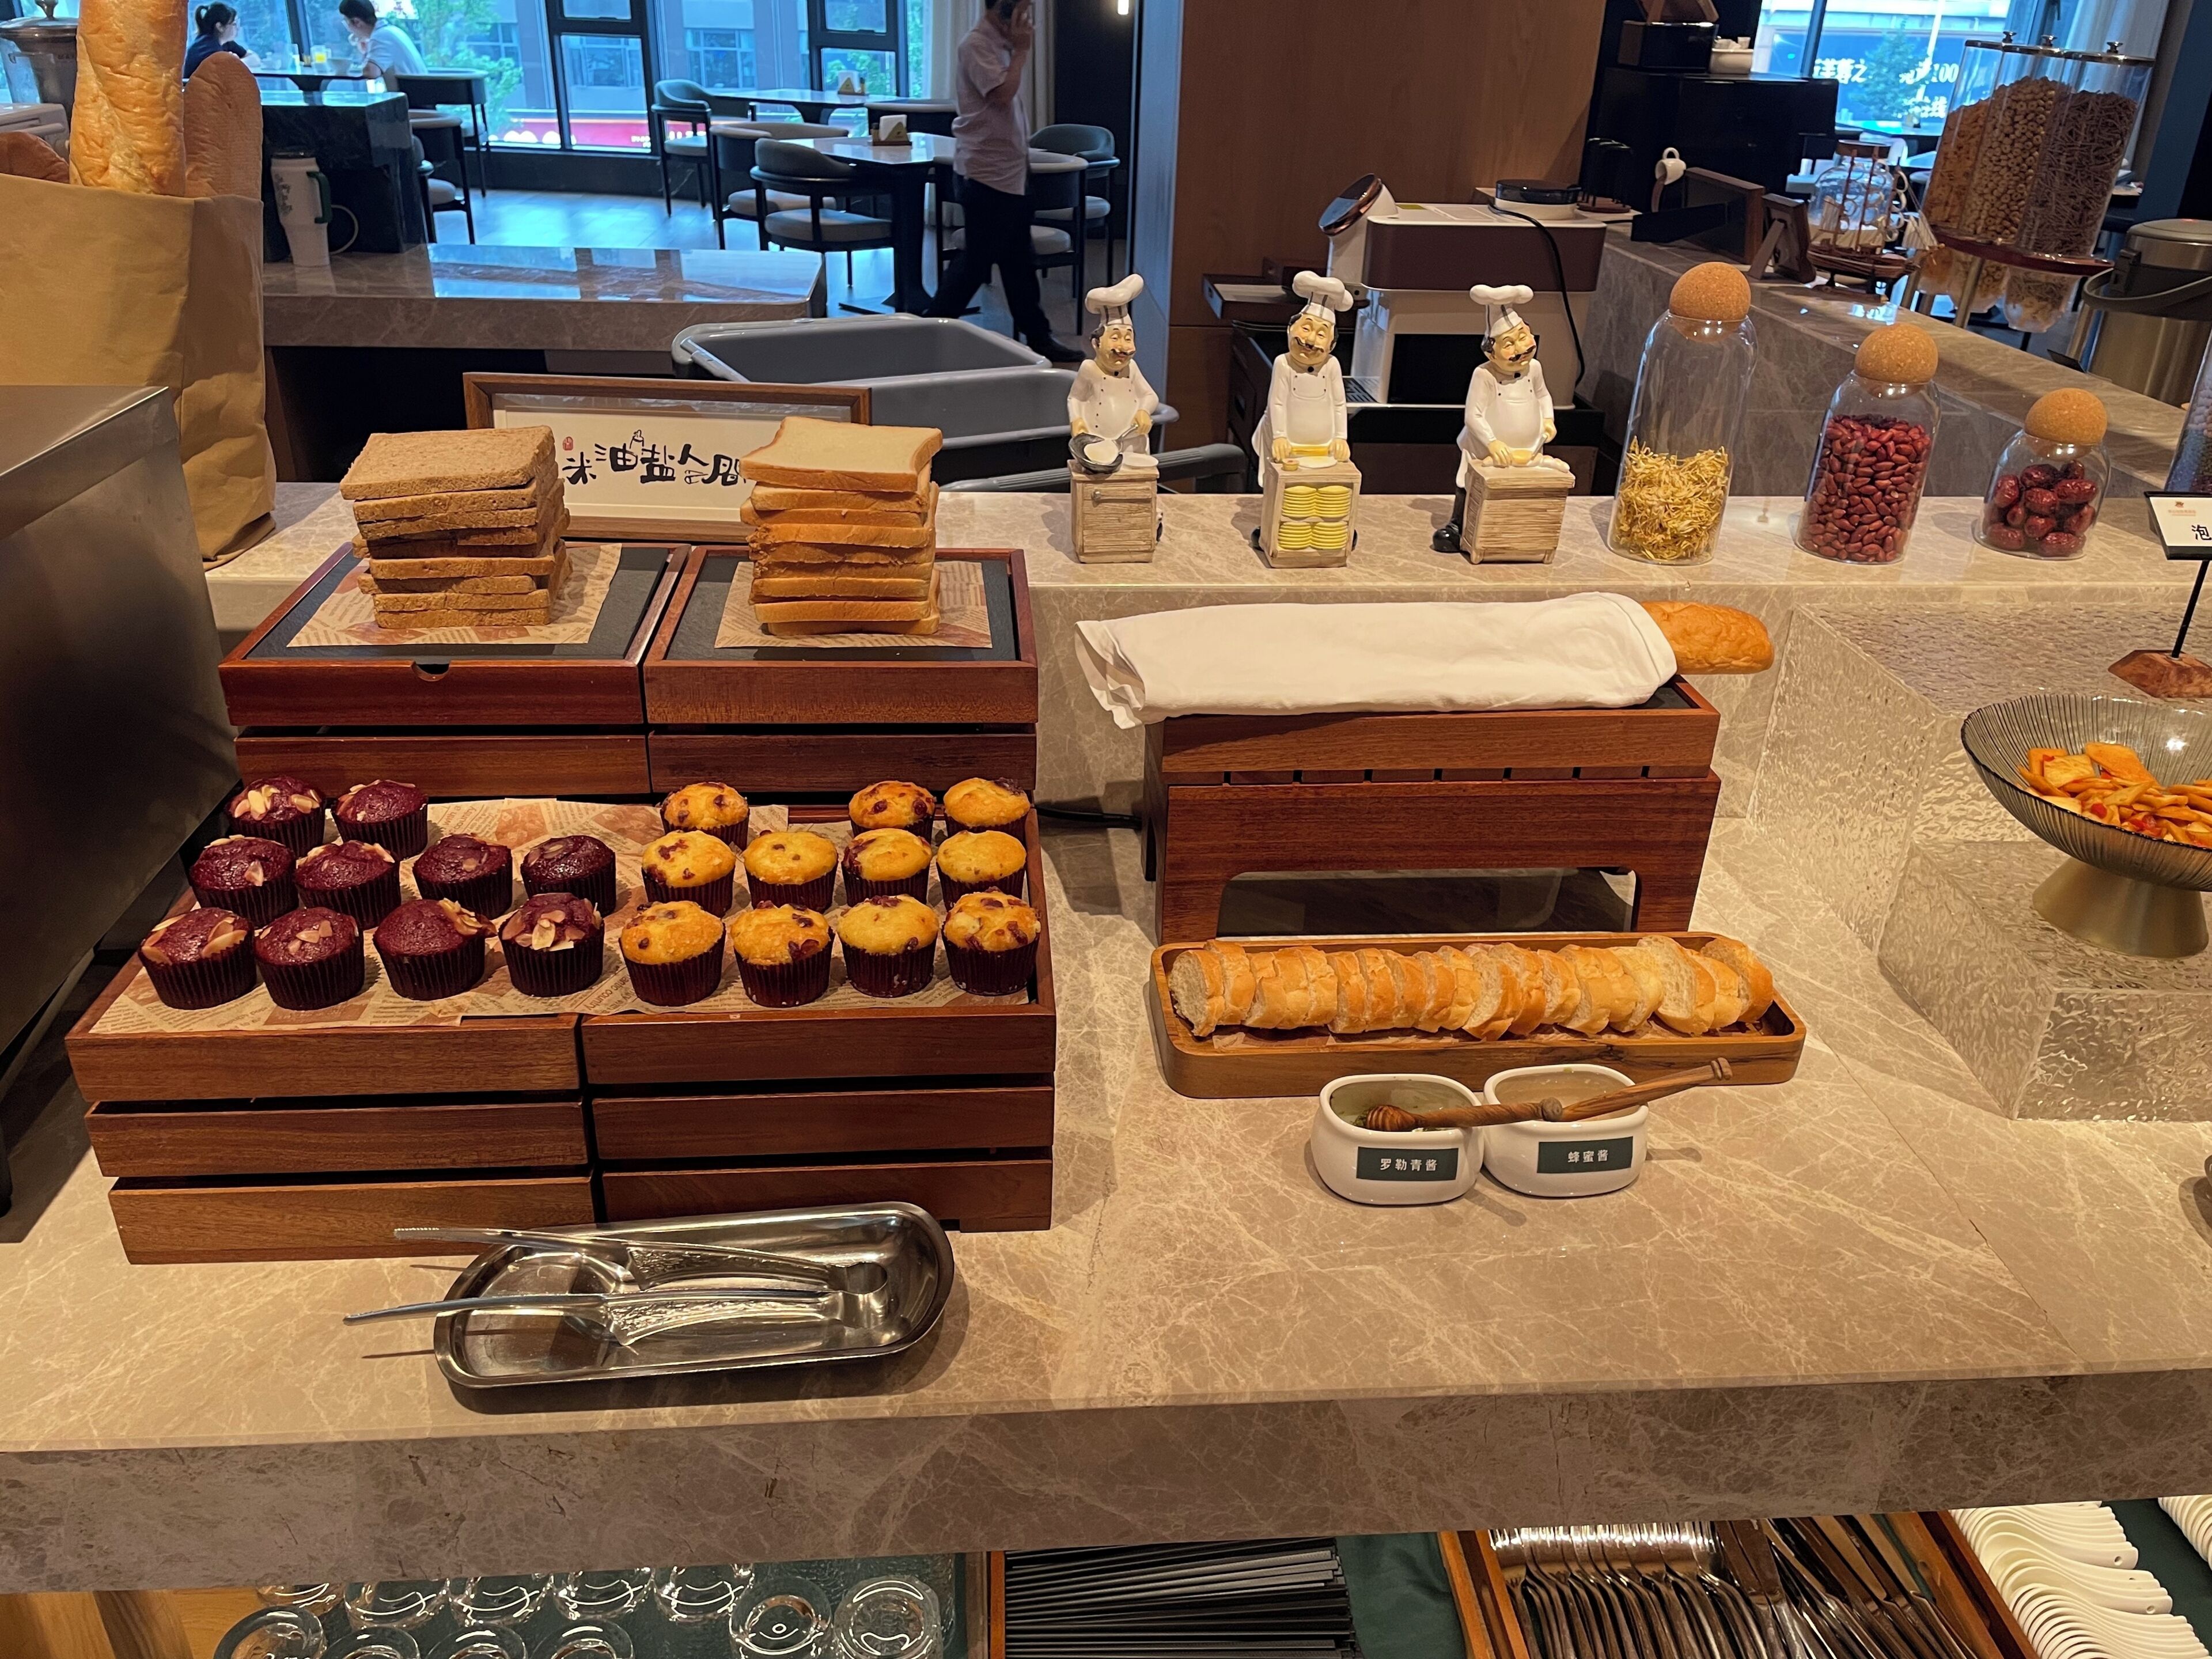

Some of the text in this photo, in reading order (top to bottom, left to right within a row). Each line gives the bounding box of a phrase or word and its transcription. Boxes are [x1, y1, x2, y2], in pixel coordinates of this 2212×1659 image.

[2191, 524, 2212, 540] 泡
[454, 805, 476, 830] country
[584, 989, 613, 1010] country
[1567, 1149, 1608, 1162] 蜂蜜酱
[1380, 1158, 1437, 1171] 罗勒青酱
